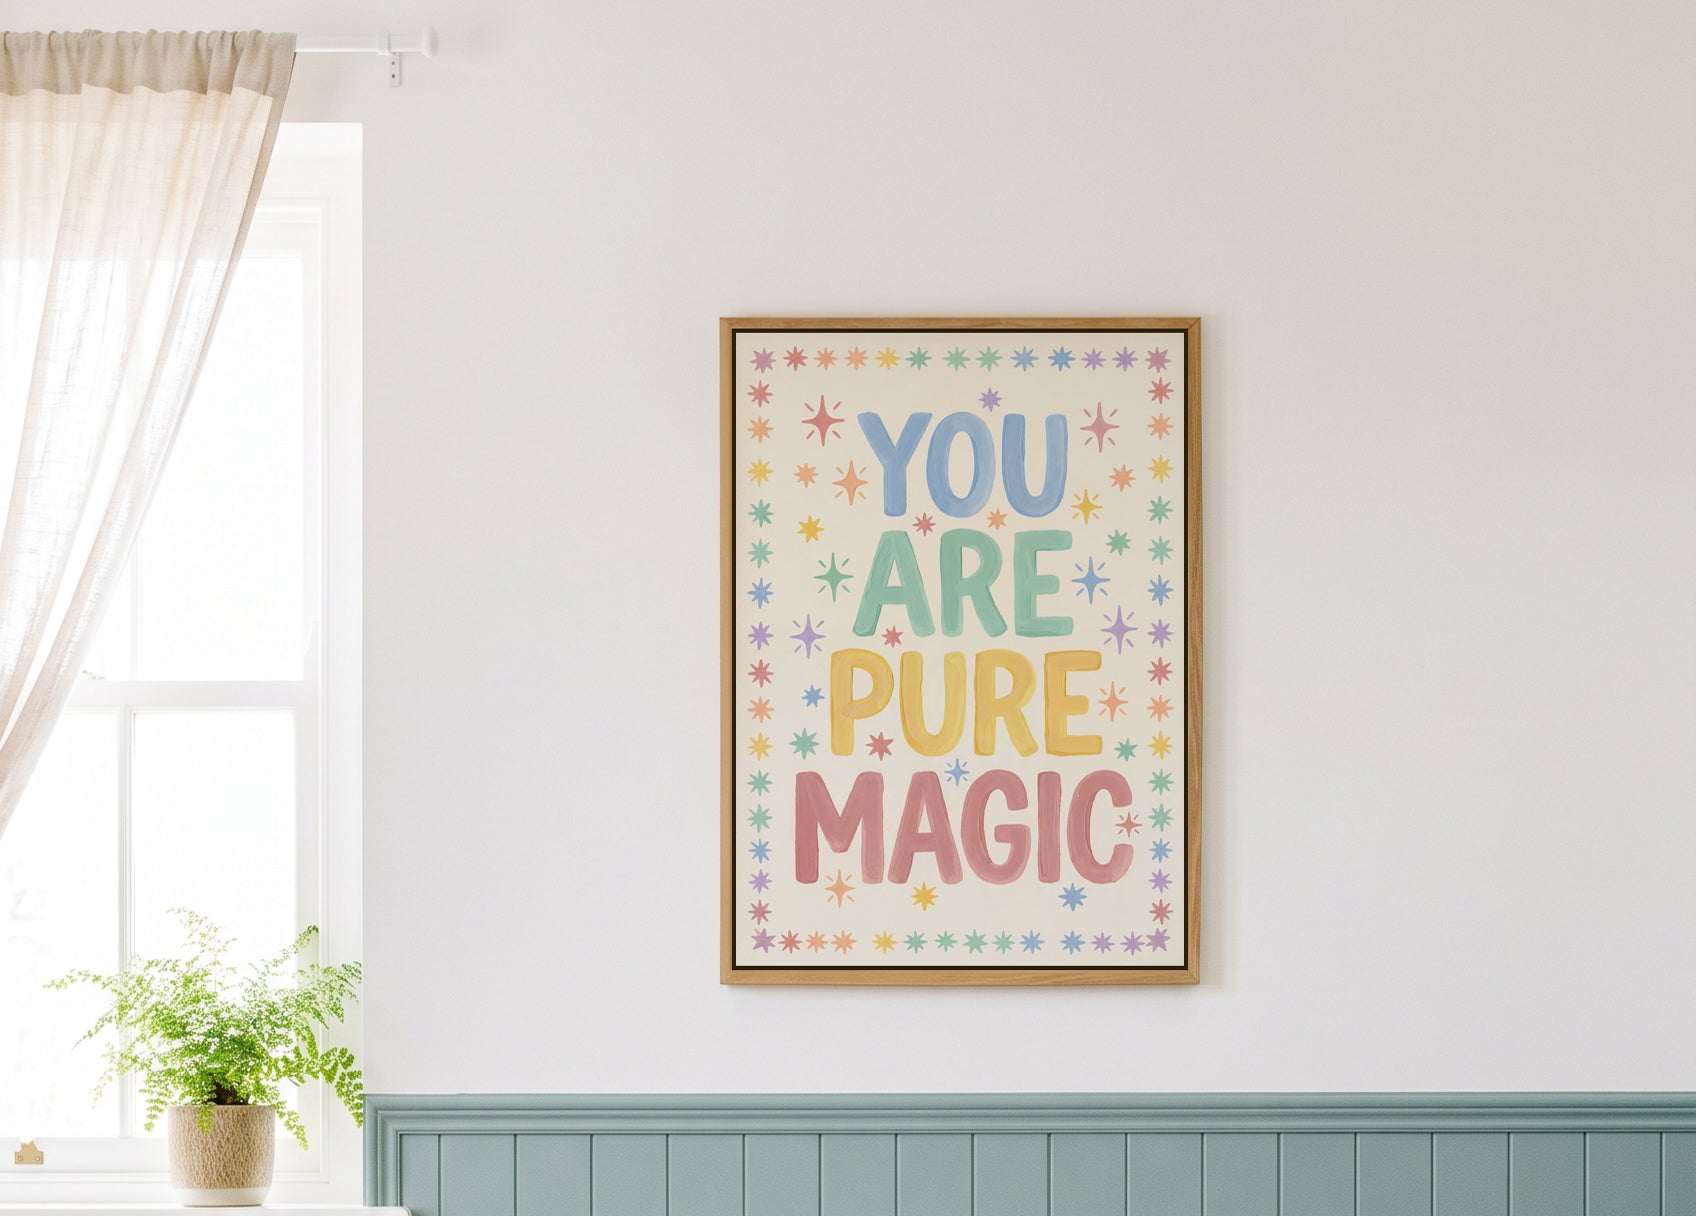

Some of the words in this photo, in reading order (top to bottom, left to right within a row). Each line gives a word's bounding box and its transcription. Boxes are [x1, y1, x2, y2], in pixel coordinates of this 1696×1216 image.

[858, 411, 1067, 518] YOU
[852, 529, 1073, 637] ARE
[830, 649, 1102, 756] PURE
[795, 769, 1133, 884] MAGIC
